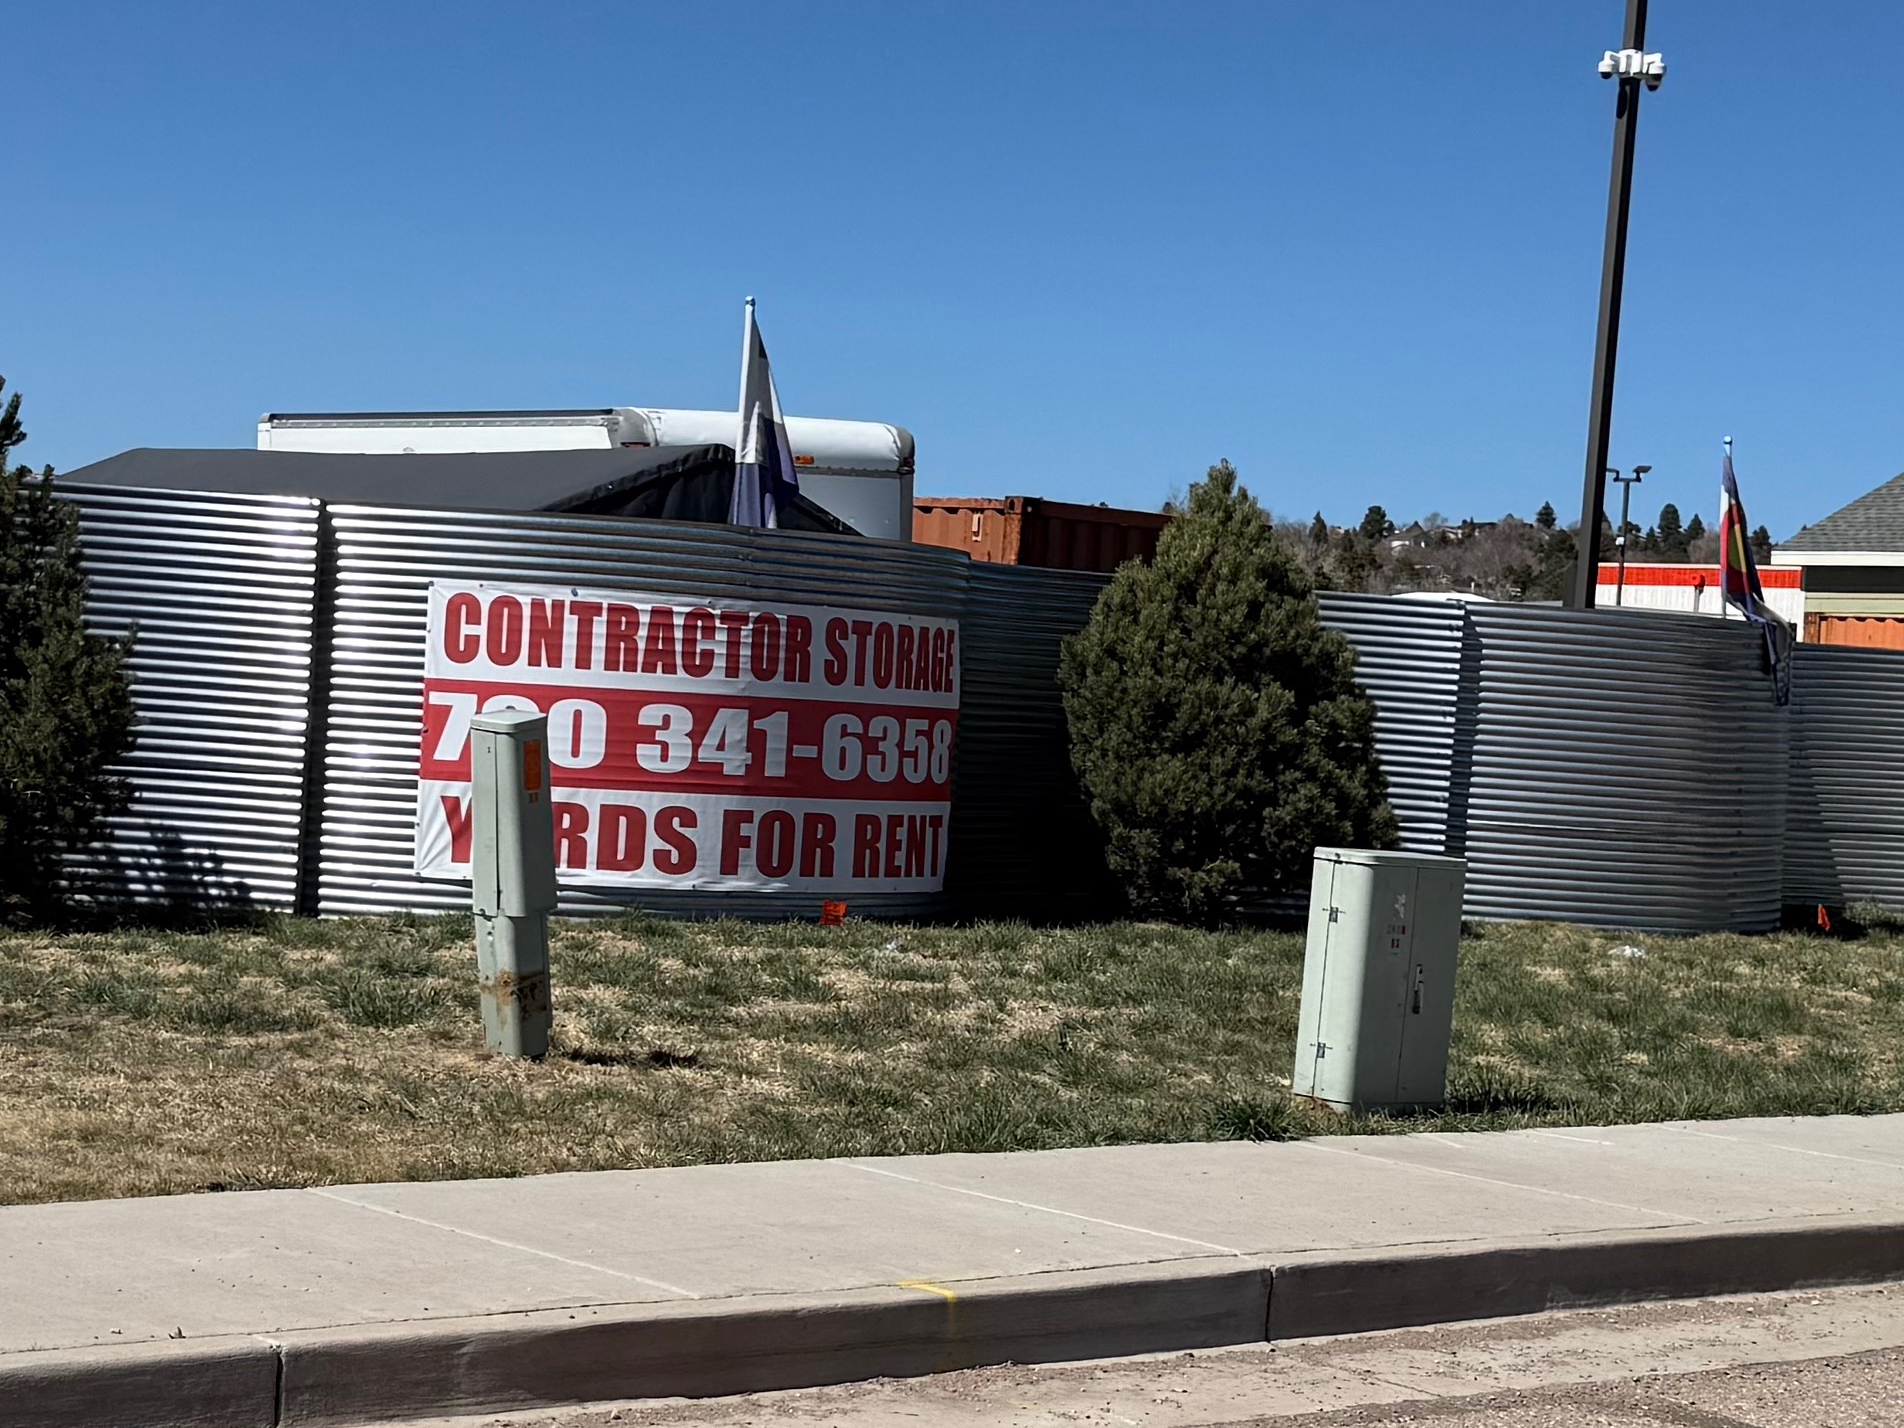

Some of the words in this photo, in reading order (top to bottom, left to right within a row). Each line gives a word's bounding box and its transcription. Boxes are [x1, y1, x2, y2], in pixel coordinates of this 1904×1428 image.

[444, 592, 812, 683] CONTRACTOR
[824, 617, 955, 693] STORAGE
[428, 691, 607, 769] 70
[636, 704, 953, 784] 341-6358
[440, 795, 698, 875] YRDS
[720, 810, 836, 878] FOR
[852, 813, 944, 878] RENT
